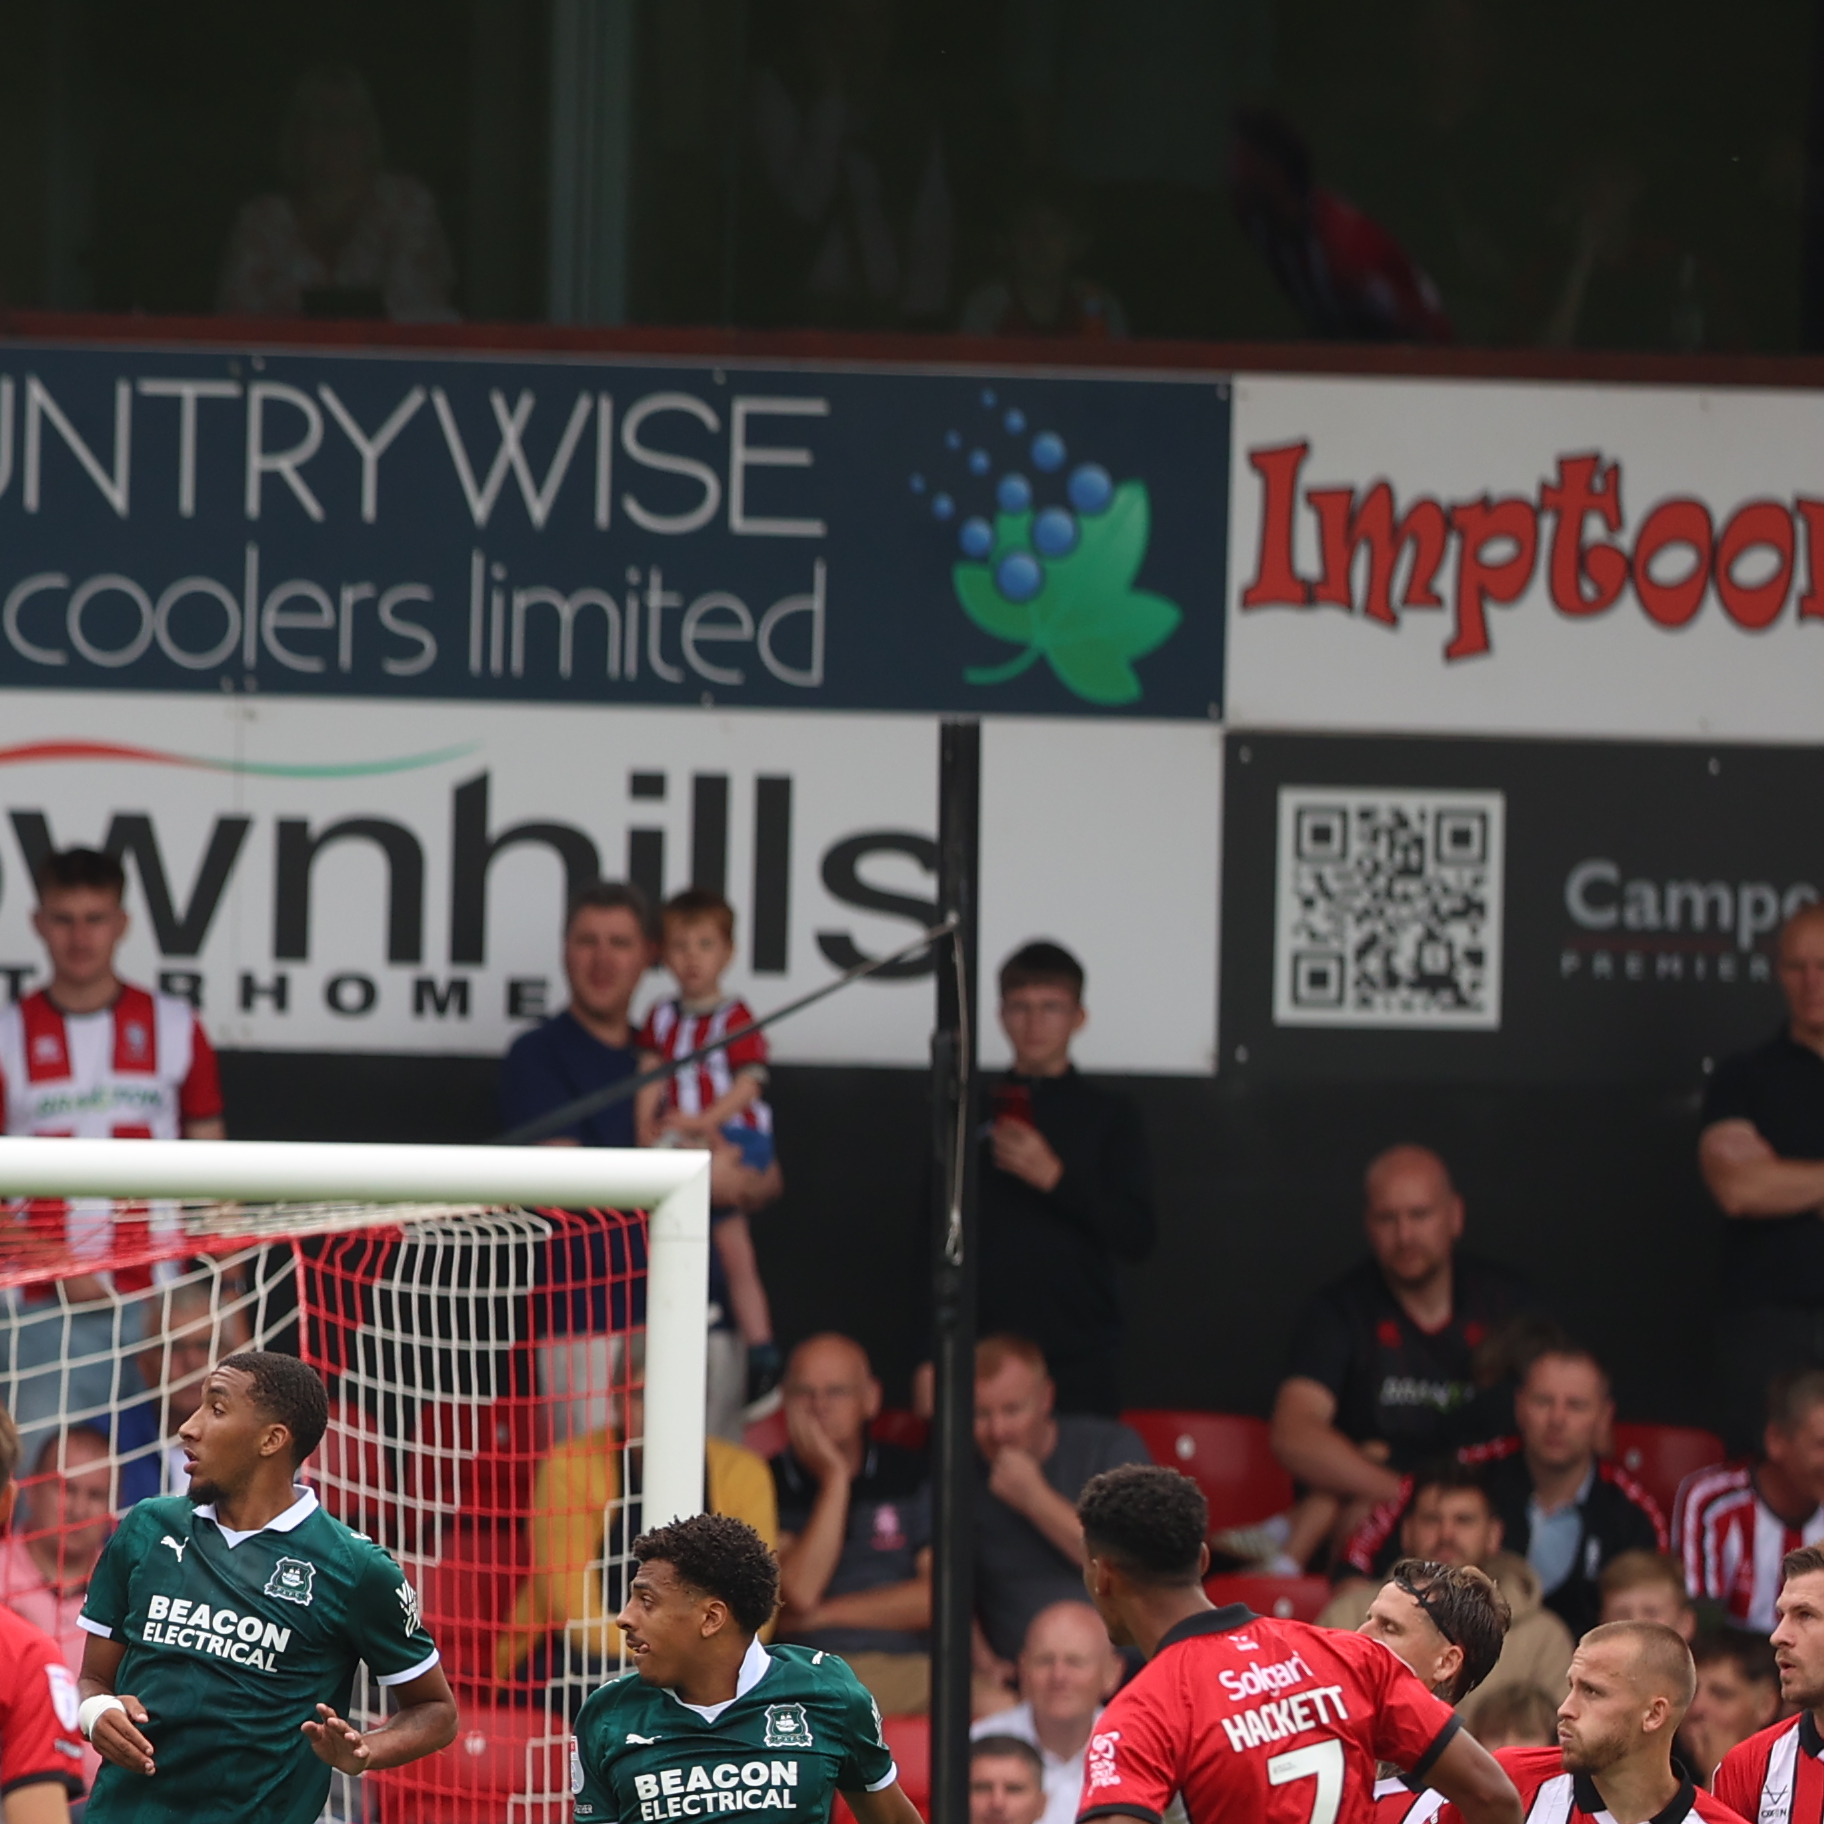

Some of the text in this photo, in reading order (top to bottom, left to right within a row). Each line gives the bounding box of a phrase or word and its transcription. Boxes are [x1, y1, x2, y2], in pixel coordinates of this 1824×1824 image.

[3, 543, 438, 674] coolers
[469, 549, 825, 688] limited
[142, 1621, 278, 1672] ELECTRICAL
[147, 1593, 291, 1653] BEACON
[1219, 1650, 1313, 1701] Solgari
[1221, 1685, 1349, 1752] HACKETT
[635, 1760, 798, 1801] BEACON
[639, 1788, 798, 1821] ELECTRICAL
